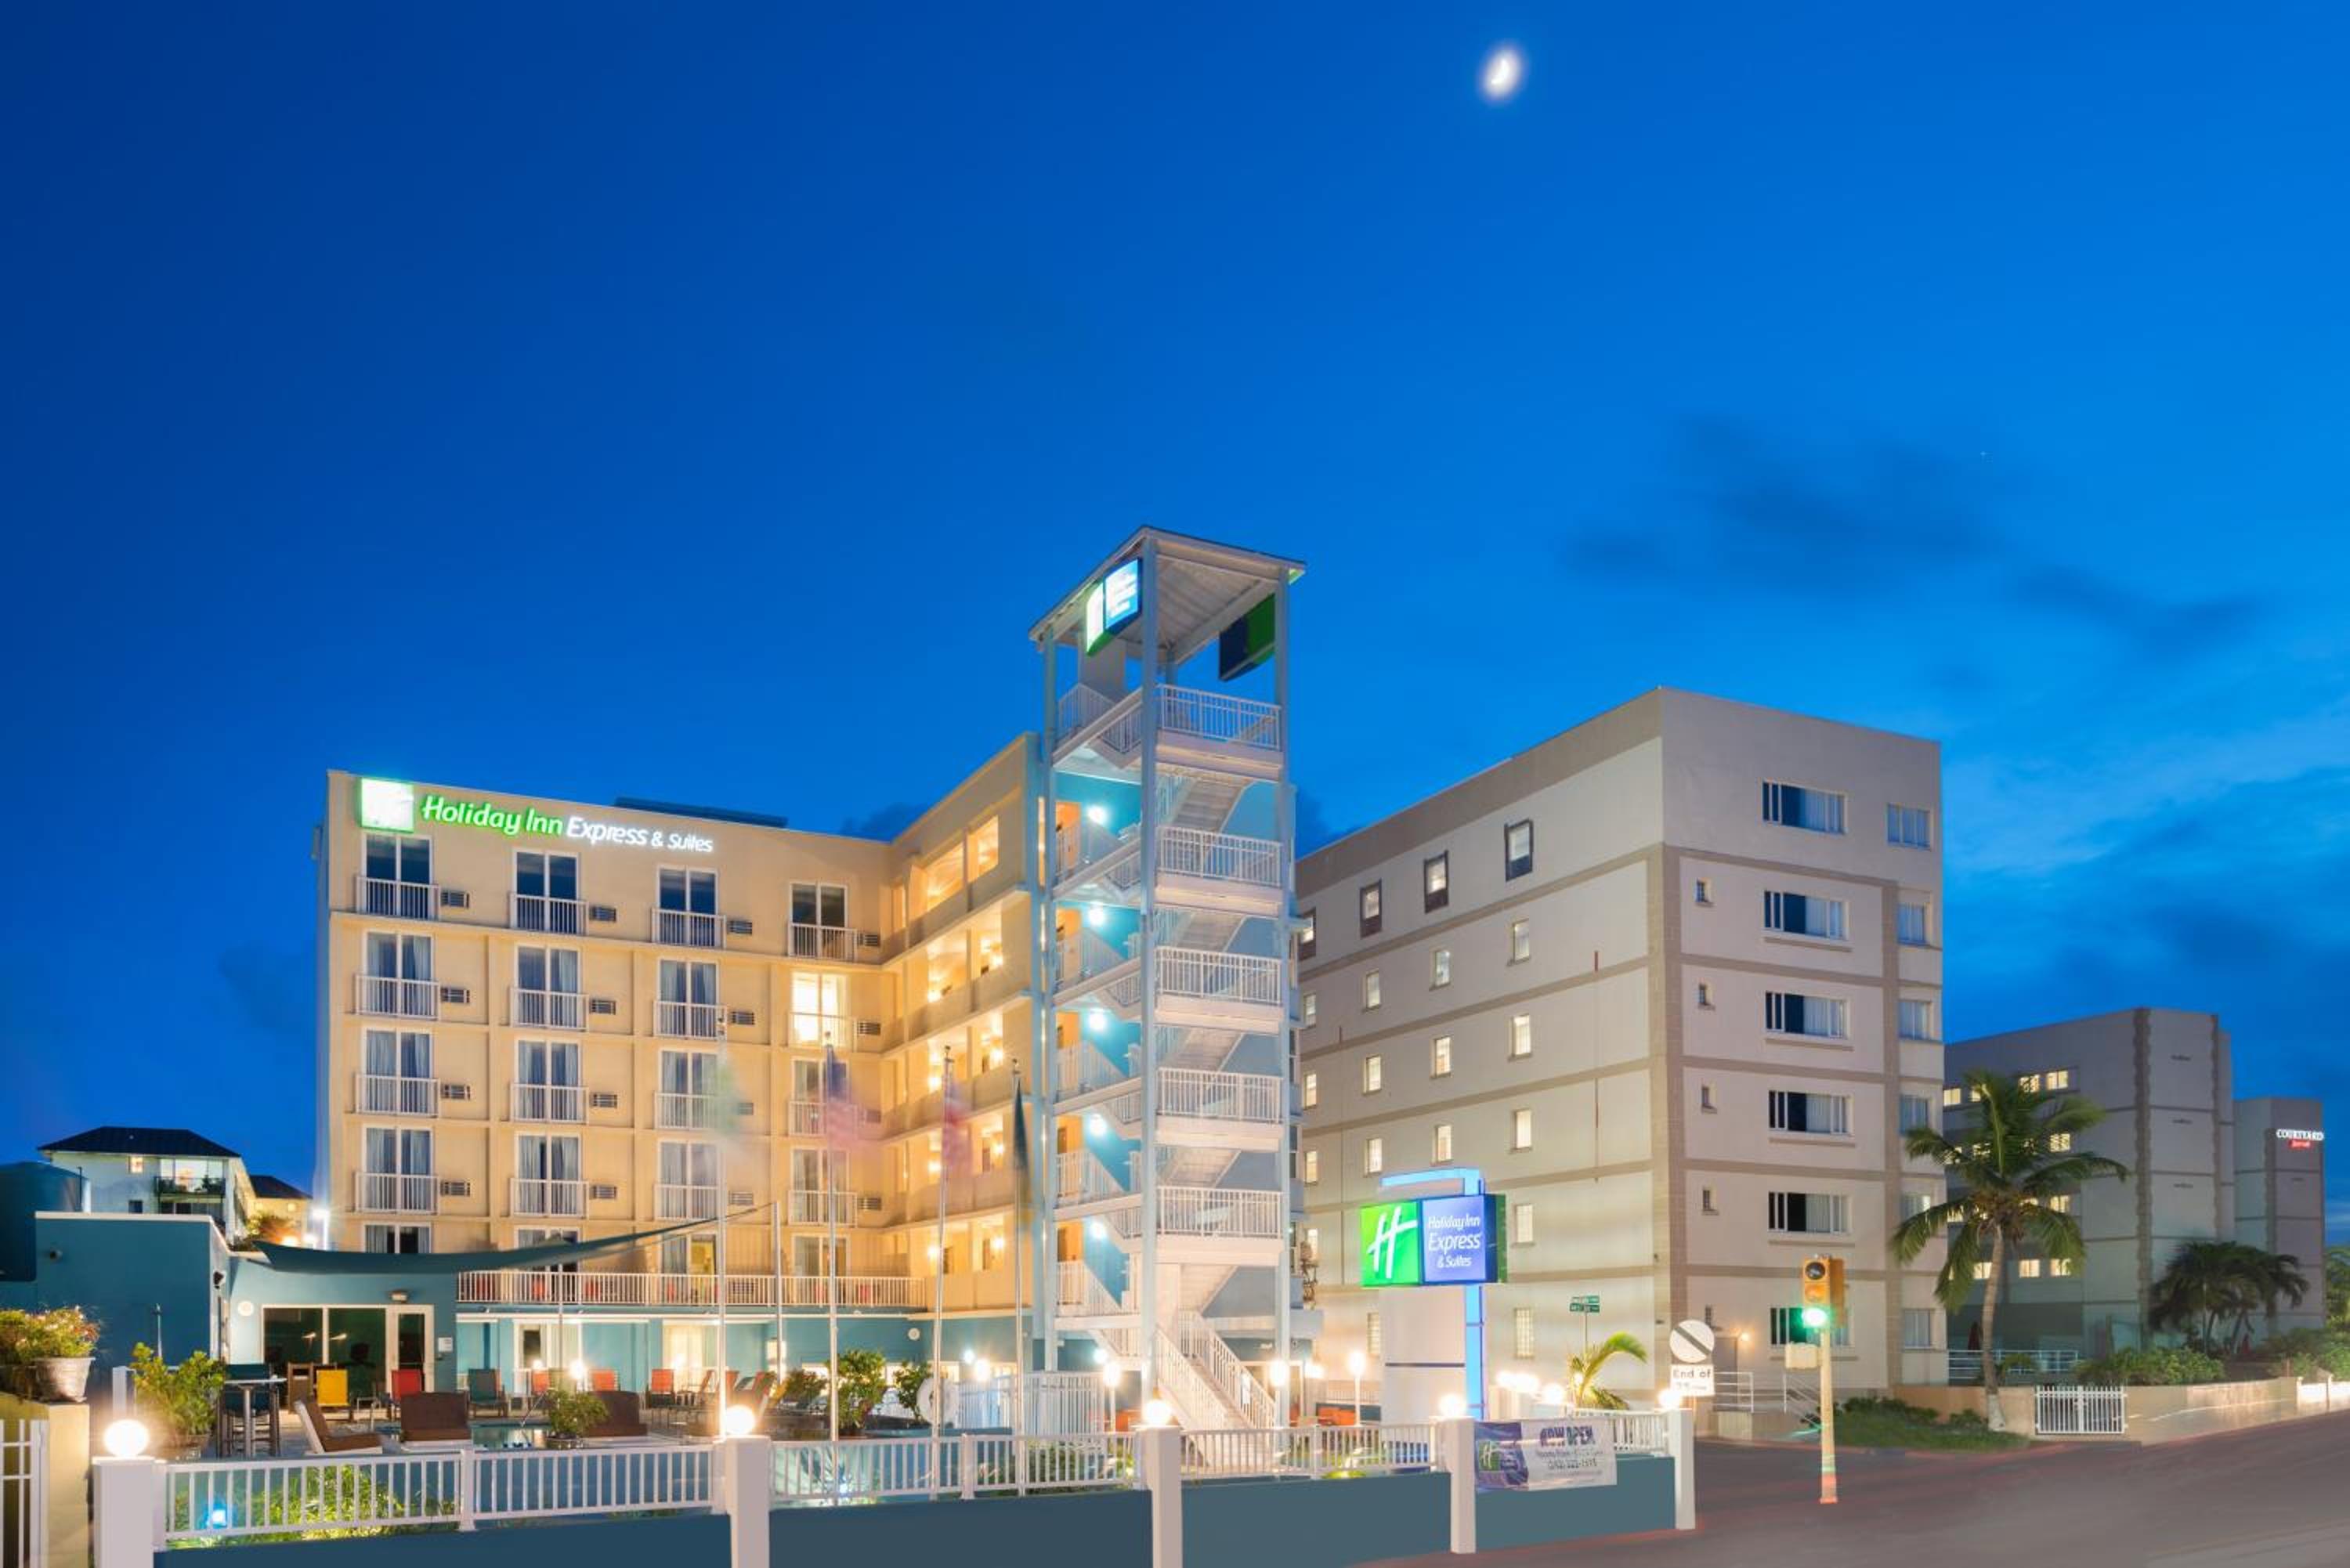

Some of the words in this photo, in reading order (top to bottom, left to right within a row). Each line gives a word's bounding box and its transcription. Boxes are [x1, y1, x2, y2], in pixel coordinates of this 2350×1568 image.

[421, 794, 522, 836] Holiday
[526, 807, 564, 836] Inn
[566, 815, 649, 846] Express
[651, 831, 664, 847] &
[667, 833, 714, 853] Suites
[2276, 1129, 2324, 1141] COURTYARD
[1428, 1215, 1464, 1231] Holiday
[1465, 1212, 1480, 1227] Inn
[1428, 1232, 1481, 1255] Express
[1437, 1255, 1444, 1268] &
[1673, 1369, 1694, 1378] End
[1699, 1368, 1711, 1378] of
